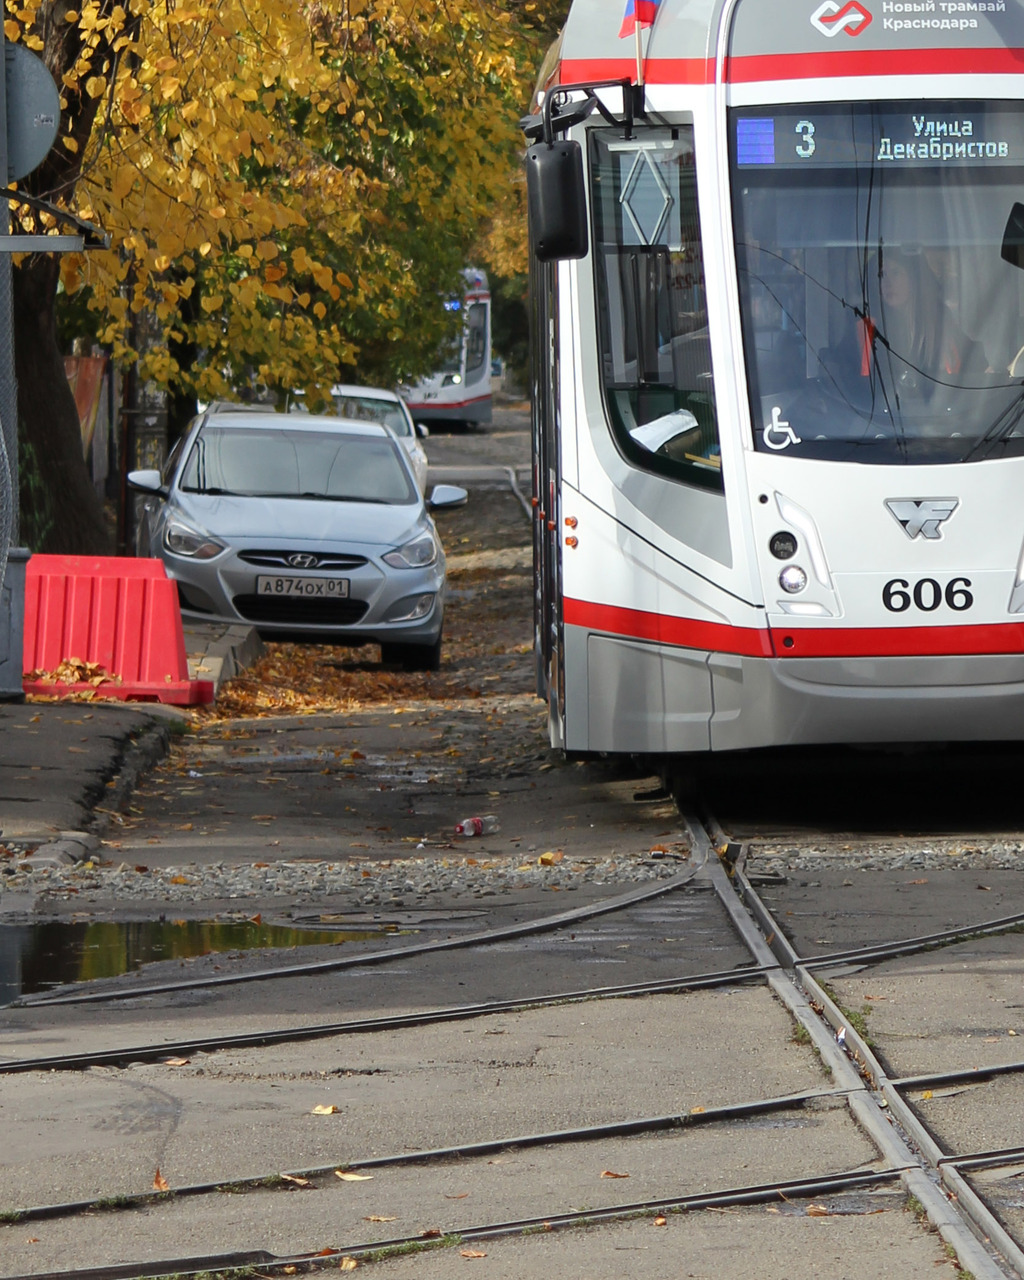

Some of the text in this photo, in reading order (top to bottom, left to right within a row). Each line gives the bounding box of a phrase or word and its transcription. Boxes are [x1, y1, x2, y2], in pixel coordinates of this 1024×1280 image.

[882, 0, 1007, 14] Новый трамвай
[882, 18, 979, 32] Краснодара
[912, 115, 973, 138] Улица
[795, 120, 816, 158] 3
[877, 137, 1010, 161] Декабристов
[882, 577, 974, 613] 606
